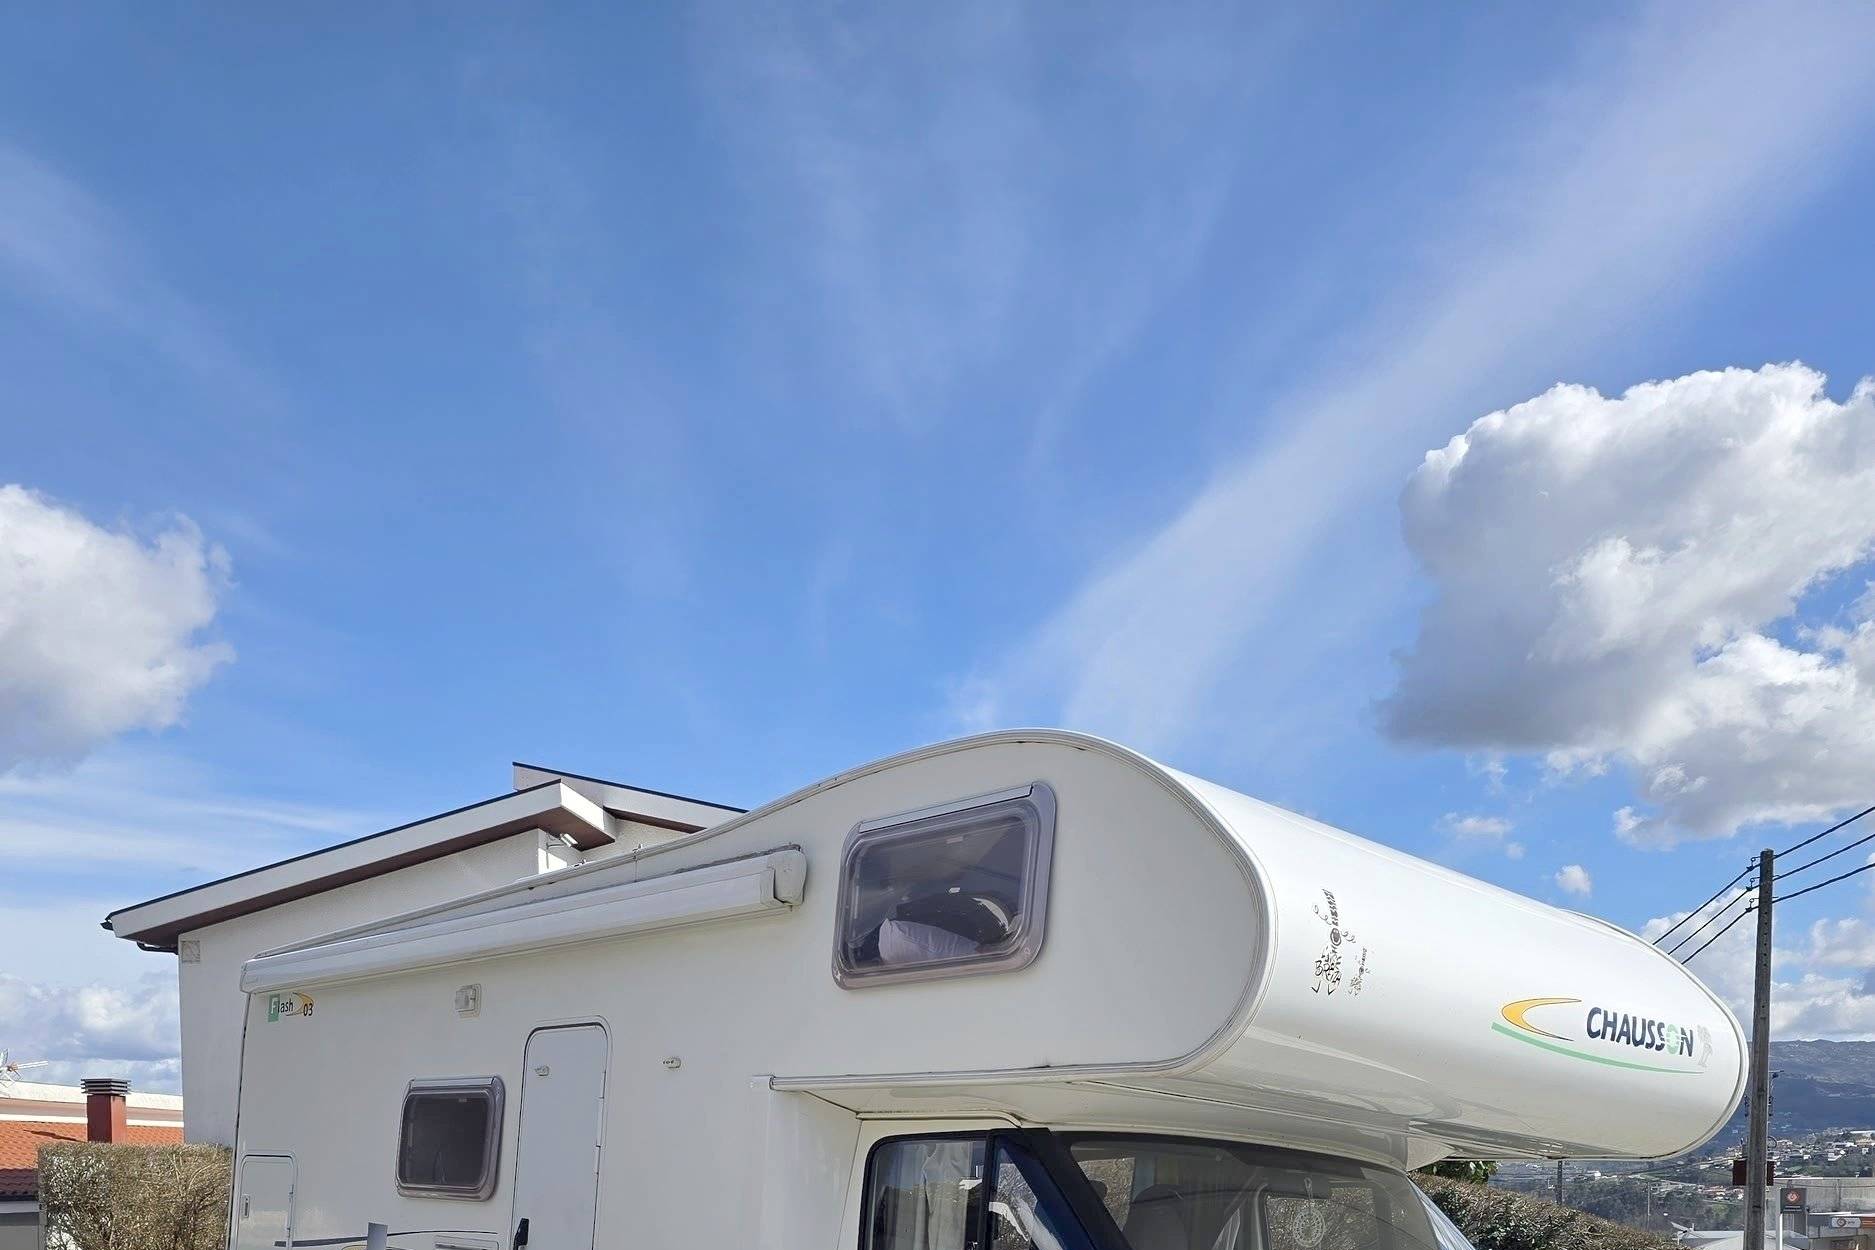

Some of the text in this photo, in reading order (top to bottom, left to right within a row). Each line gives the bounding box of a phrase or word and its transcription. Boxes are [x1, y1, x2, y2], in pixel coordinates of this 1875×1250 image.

[270, 997, 313, 1016] Flash 03
[1586, 1007, 1694, 1057] CHAUSSON
